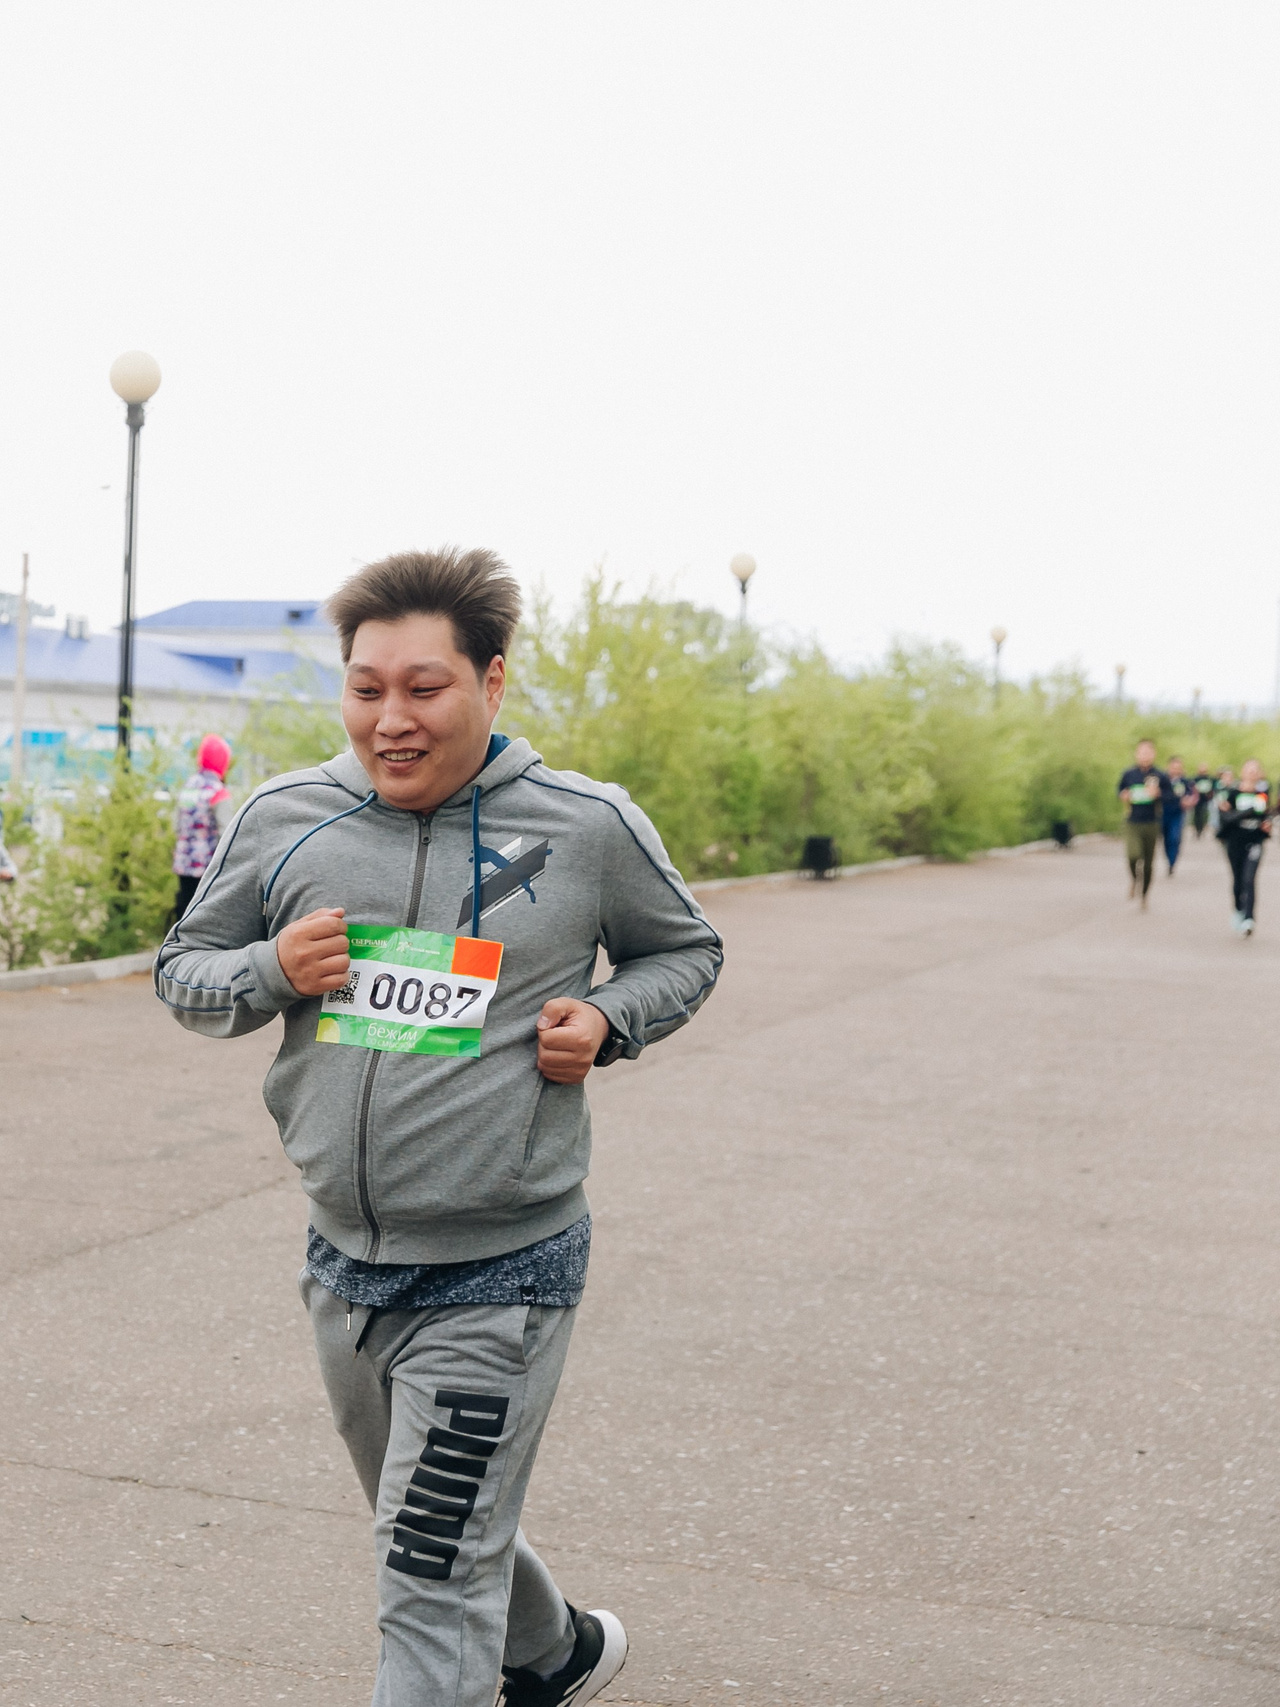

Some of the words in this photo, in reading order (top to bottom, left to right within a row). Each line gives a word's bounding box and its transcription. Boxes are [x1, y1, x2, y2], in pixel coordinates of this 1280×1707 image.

[369, 973, 482, 1020] 0087
[367, 1022, 418, 1041] бежим
[386, 1389, 510, 1581] PUMA
